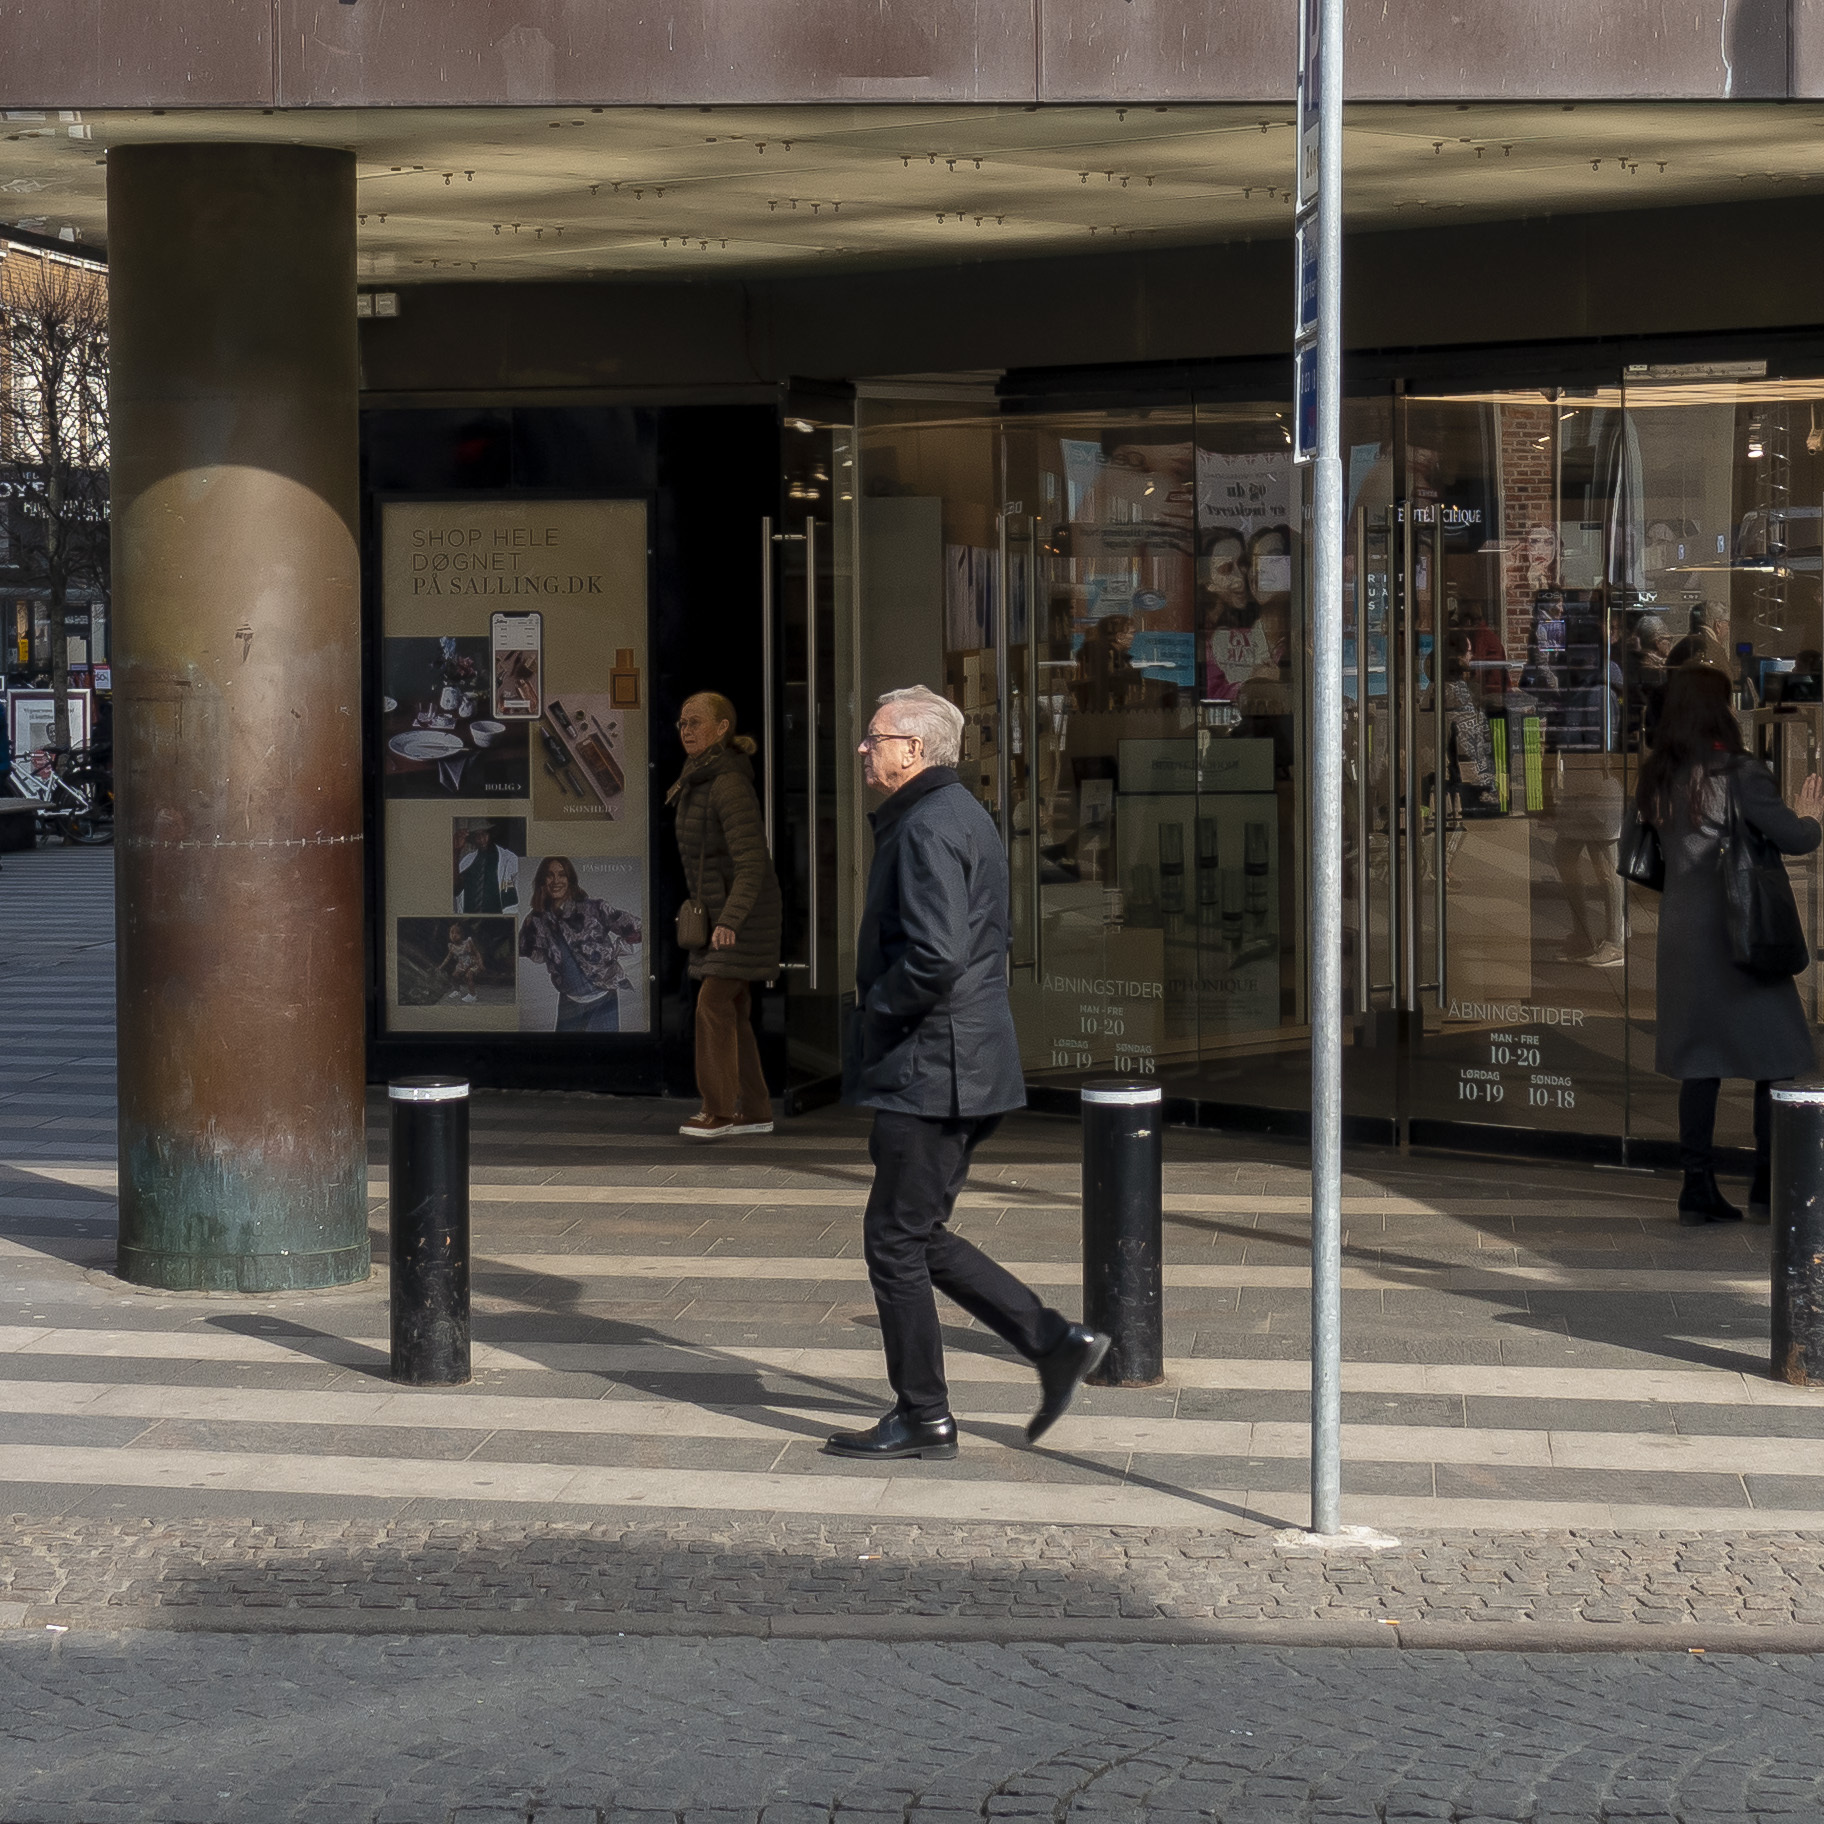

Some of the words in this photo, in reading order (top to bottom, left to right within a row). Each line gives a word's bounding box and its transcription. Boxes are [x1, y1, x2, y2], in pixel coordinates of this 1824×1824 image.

[411, 527, 482, 548] SHOP
[493, 527, 561, 548] HELE
[412, 551, 523, 572] DØGNET
[412, 573, 443, 596] PÅ
[449, 575, 604, 595] SALLING.DK
[484, 781, 515, 792] BOLIG
[582, 862, 627, 874] FASHION
[1041, 972, 1164, 1000] ÅBNINGSTIDER
[1107, 1006, 1124, 1017] FRE
[1447, 997, 1585, 1027] ÅBNINGSTIDER
[1079, 1016, 1126, 1037] 10-20
[1490, 1032, 1513, 1044] MAN
[1520, 1034, 1540, 1046] FRE
[1113, 1054, 1156, 1075] 10-18
[1490, 1044, 1541, 1068] 10-20
[1460, 1068, 1501, 1081] LØRDAG
[1530, 1074, 1572, 1087] SØNDAG
[1457, 1081, 1505, 1103] 10-19
[1528, 1087, 1575, 1109] 10-18
